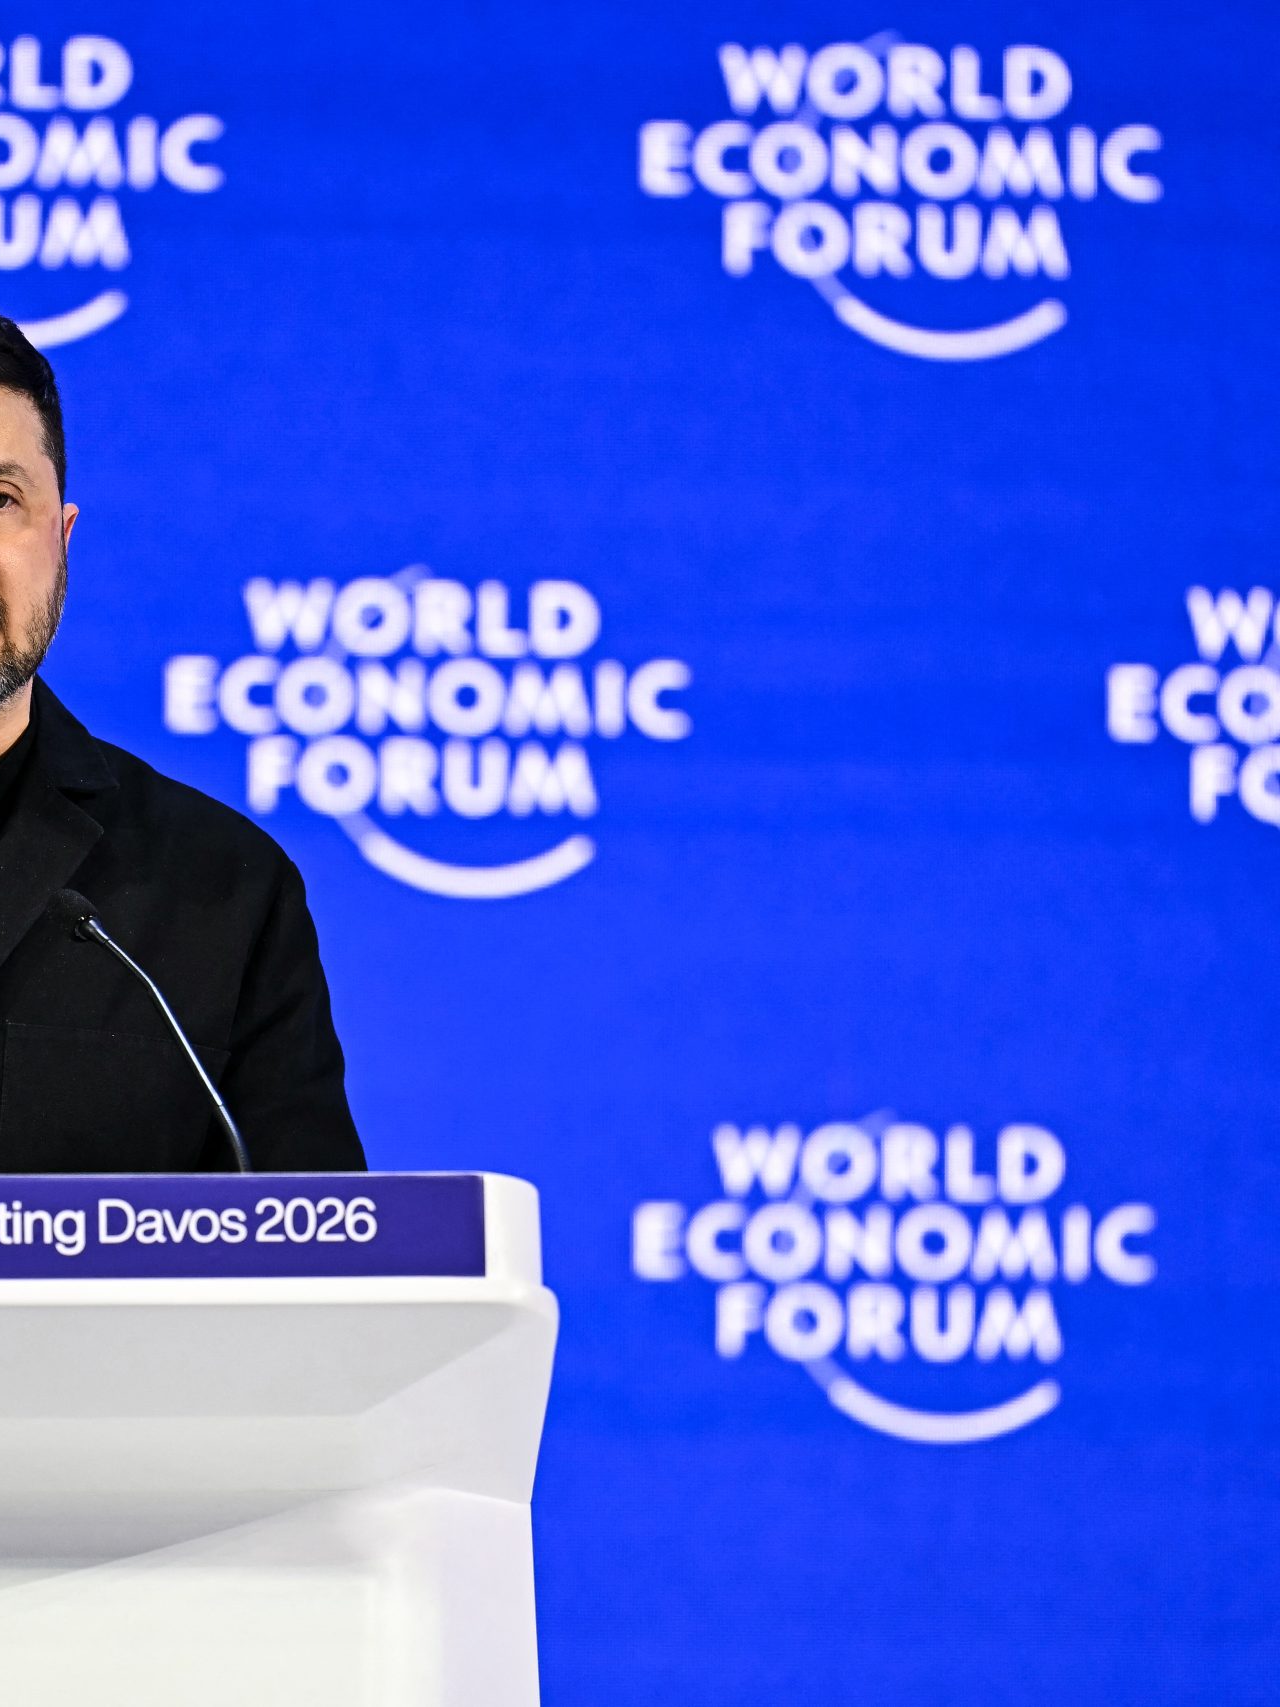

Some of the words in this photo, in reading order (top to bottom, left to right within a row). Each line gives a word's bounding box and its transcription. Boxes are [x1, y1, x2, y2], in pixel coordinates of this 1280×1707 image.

[719, 42, 1073, 121] WORLD
[639, 119, 1163, 203] ECONOMIC
[722, 201, 1071, 281] FORUM
[242, 577, 602, 660] WORLD
[163, 655, 692, 740] ECONOMIC
[246, 734, 598, 819] FORUM
[712, 1121, 1066, 1205] WORLD
[98, 1198, 248, 1244] Davos
[254, 1197, 378, 1243] 2026
[632, 1202, 1157, 1287] ECONOMIC
[715, 1281, 1064, 1363] FORUM
